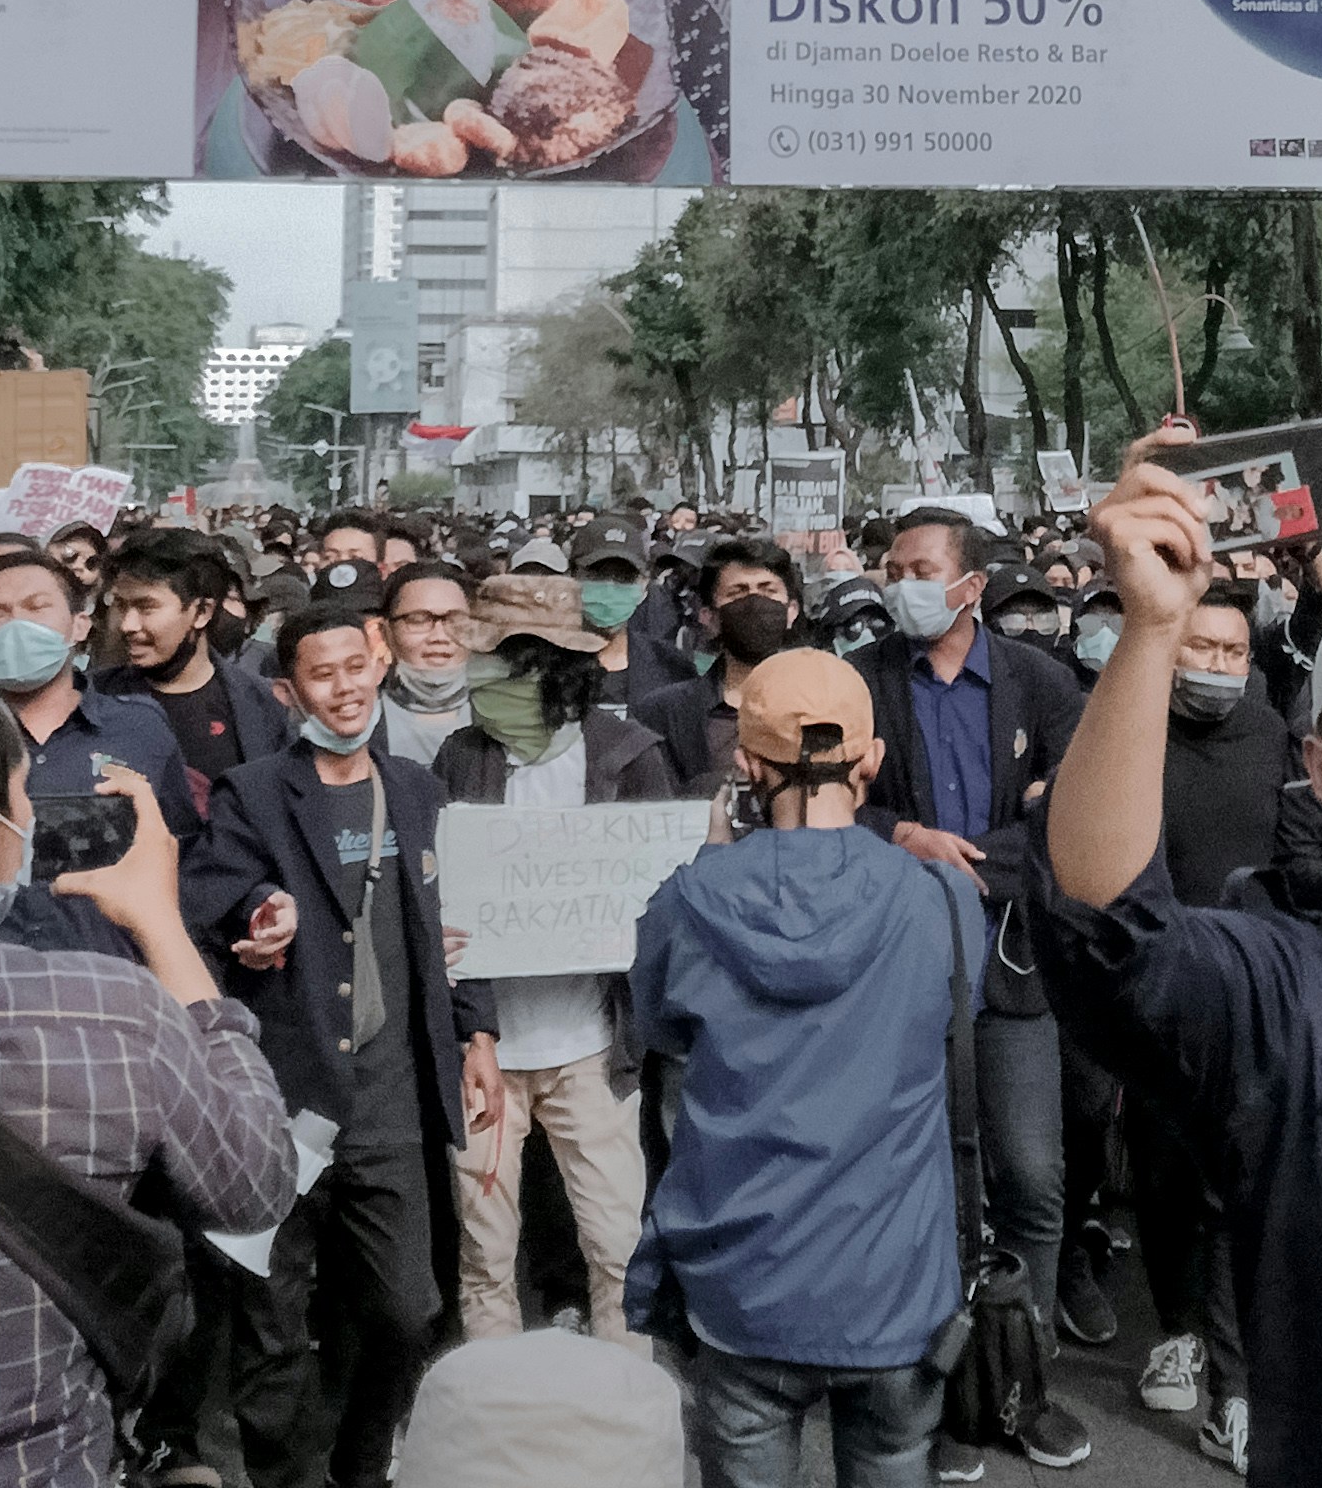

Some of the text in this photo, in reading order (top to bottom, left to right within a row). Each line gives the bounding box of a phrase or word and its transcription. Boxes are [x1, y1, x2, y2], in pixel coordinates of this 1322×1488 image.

[766, 40, 1108, 66] di Djaman Doeloe Resto & Bar
[770, 82, 1083, 110] Hingga 30 November 2020
[808, 130, 993, 155] (031) 991 50000
